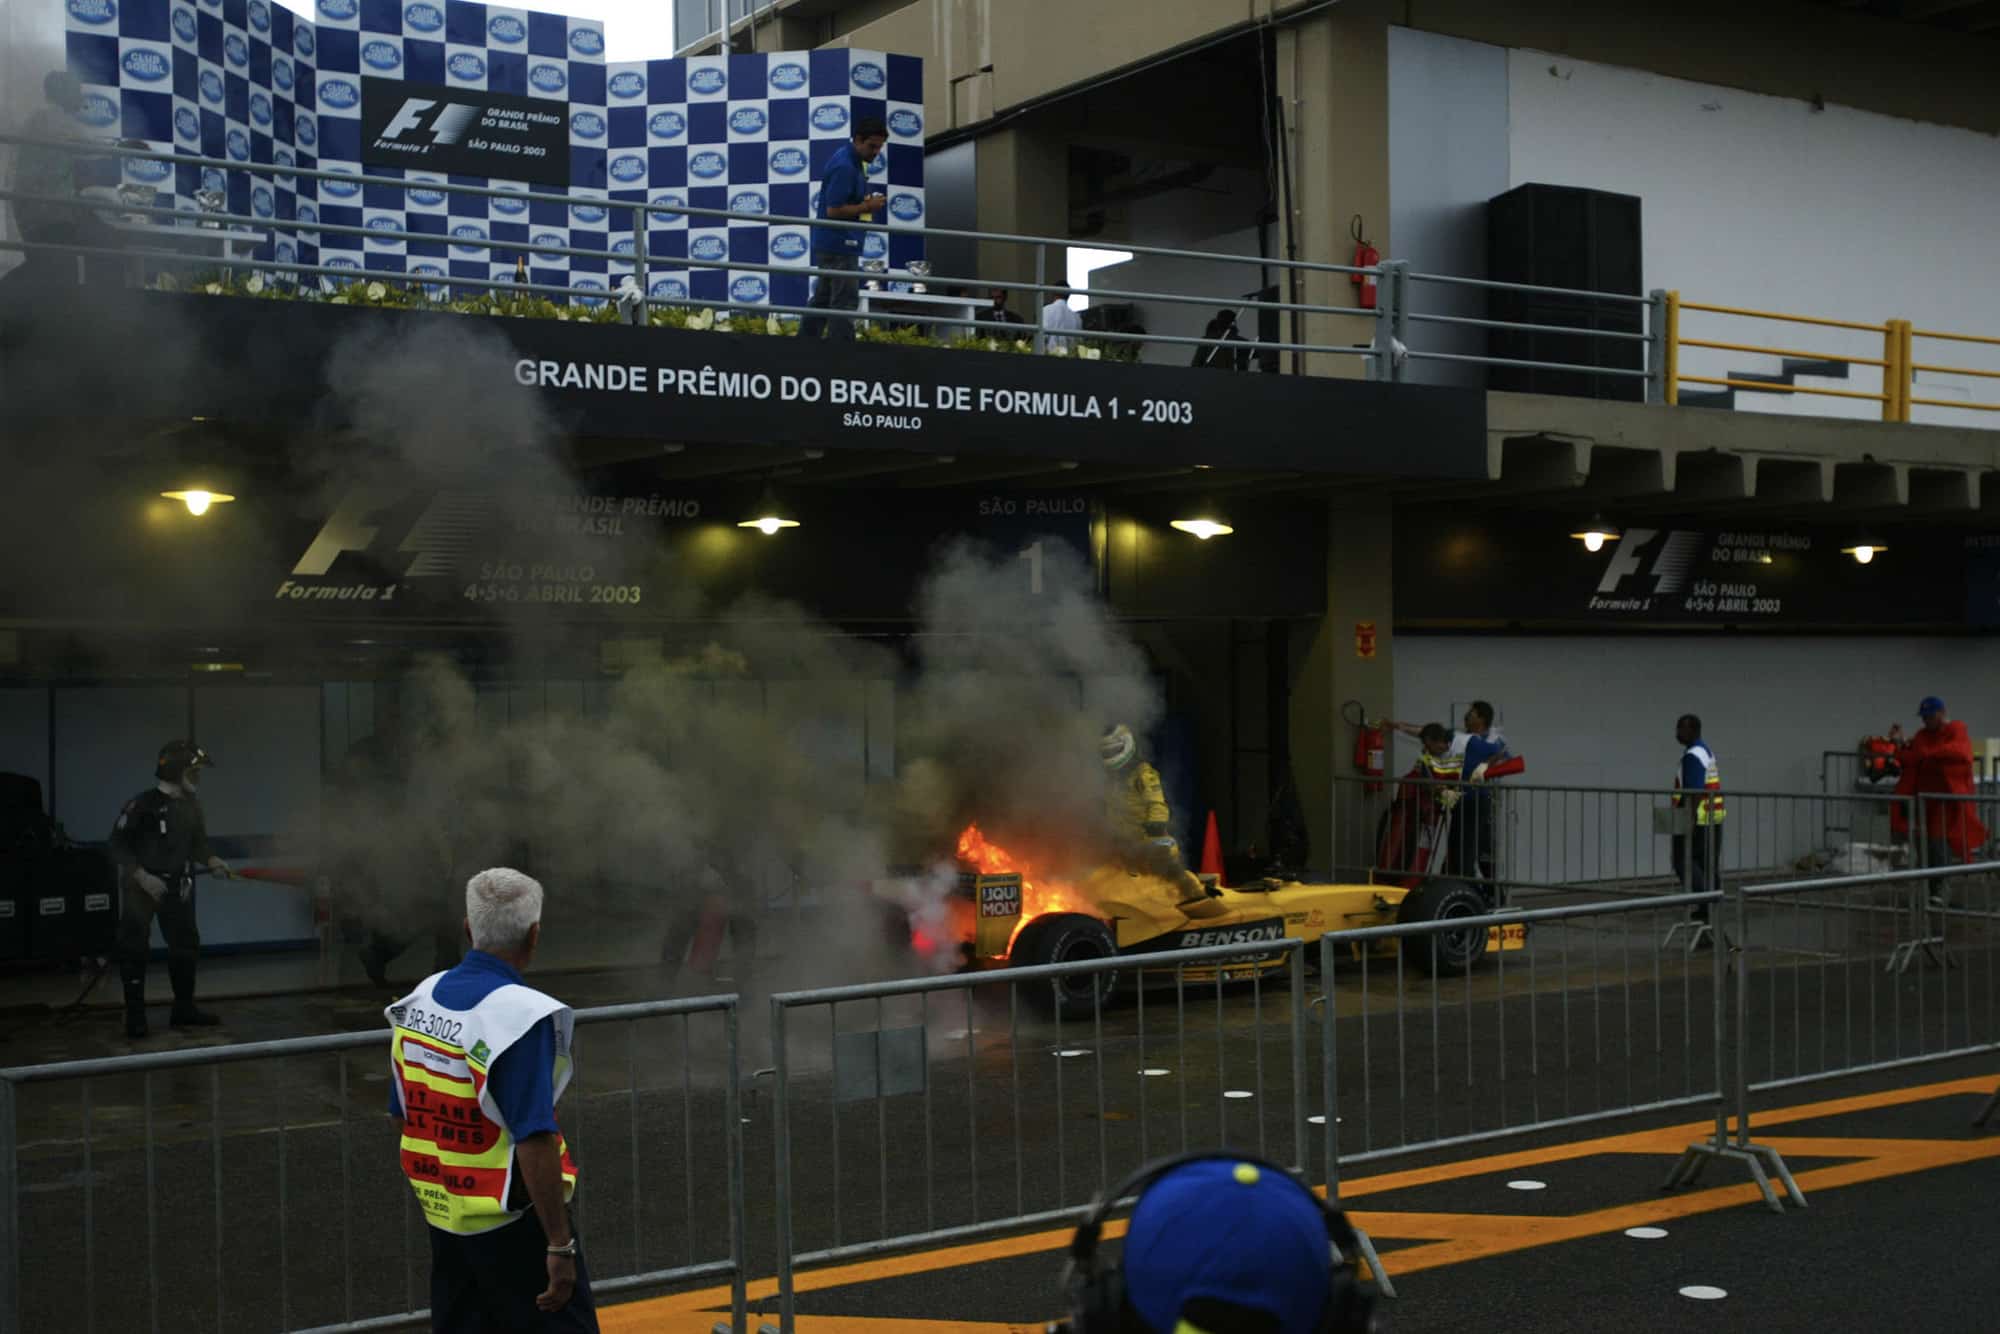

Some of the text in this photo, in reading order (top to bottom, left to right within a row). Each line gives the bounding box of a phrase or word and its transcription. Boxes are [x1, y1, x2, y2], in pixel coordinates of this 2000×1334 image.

[126, 61, 165, 73] SOCIAL
[131, 52, 161, 64] CLUB
[481, 117, 529, 131] DO BRASIL
[487, 108, 561, 125] GRANDE PRÊMIO
[374, 138, 430, 154] Formula 1
[467, 137, 546, 157] SÃO PAULO 2003
[692, 247, 723, 255] SOCIAL
[514, 359, 648, 393] GRANDE
[658, 365, 772, 399] PRÊMIO
[780, 376, 822, 401] DO
[831, 379, 928, 409] BRASIL
[936, 385, 971, 411] DE
[979, 388, 1101, 418] FORMULA
[1108, 397, 1118, 420] 1
[1141, 399, 1193, 424] 2003
[843, 411, 922, 430] SÃO PAULO
[622, 493, 700, 519] PRÊMIO
[978, 496, 1086, 516] SÃO PAULO
[1719, 531, 1812, 551] GRANDE PRÊMIO
[1712, 548, 1730, 561] DO
[479, 561, 595, 582] SÃO PAULO
[1017, 541, 1043, 595] 1
[275, 581, 396, 602] Formula 1
[525, 585, 583, 604] ABRIL
[590, 585, 641, 604] 2003
[1693, 582, 1757, 598] SÃO PAULO
[1589, 595, 1651, 611] Formula 1
[1717, 598, 1752, 613] ABRIL
[1753, 599, 1781, 614] 2003
[982, 902, 1019, 917] MOLY
[1179, 925, 1278, 947] BENSON
[413, 1157, 440, 1178] SÃO
